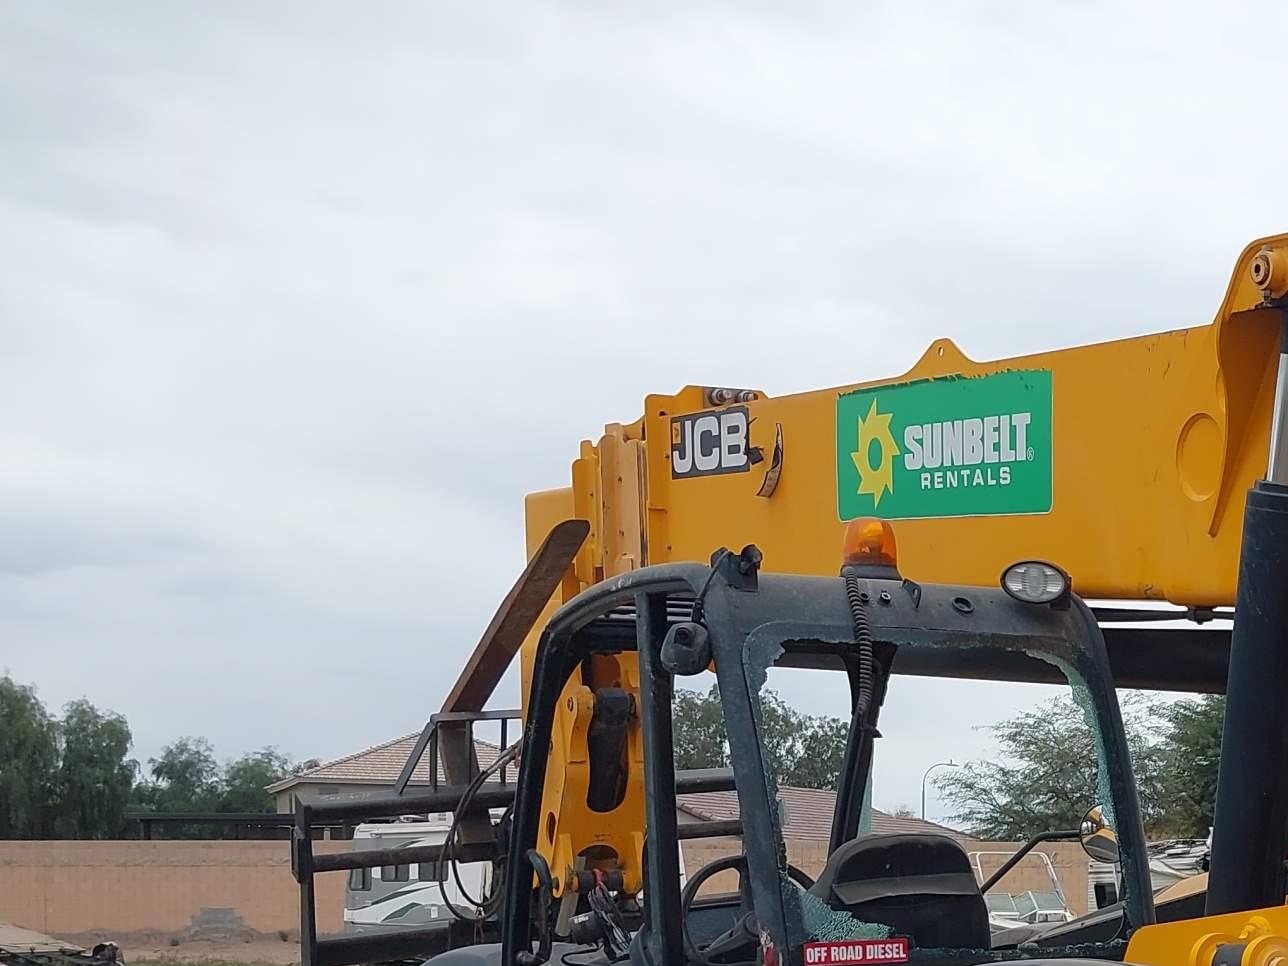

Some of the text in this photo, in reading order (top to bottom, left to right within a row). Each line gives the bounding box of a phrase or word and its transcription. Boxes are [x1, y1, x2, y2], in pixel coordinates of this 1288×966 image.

[673, 411, 749, 474] JCB
[920, 467, 1011, 489] RENTALS
[806, 942, 907, 963] OFF ROAD DIESEL
